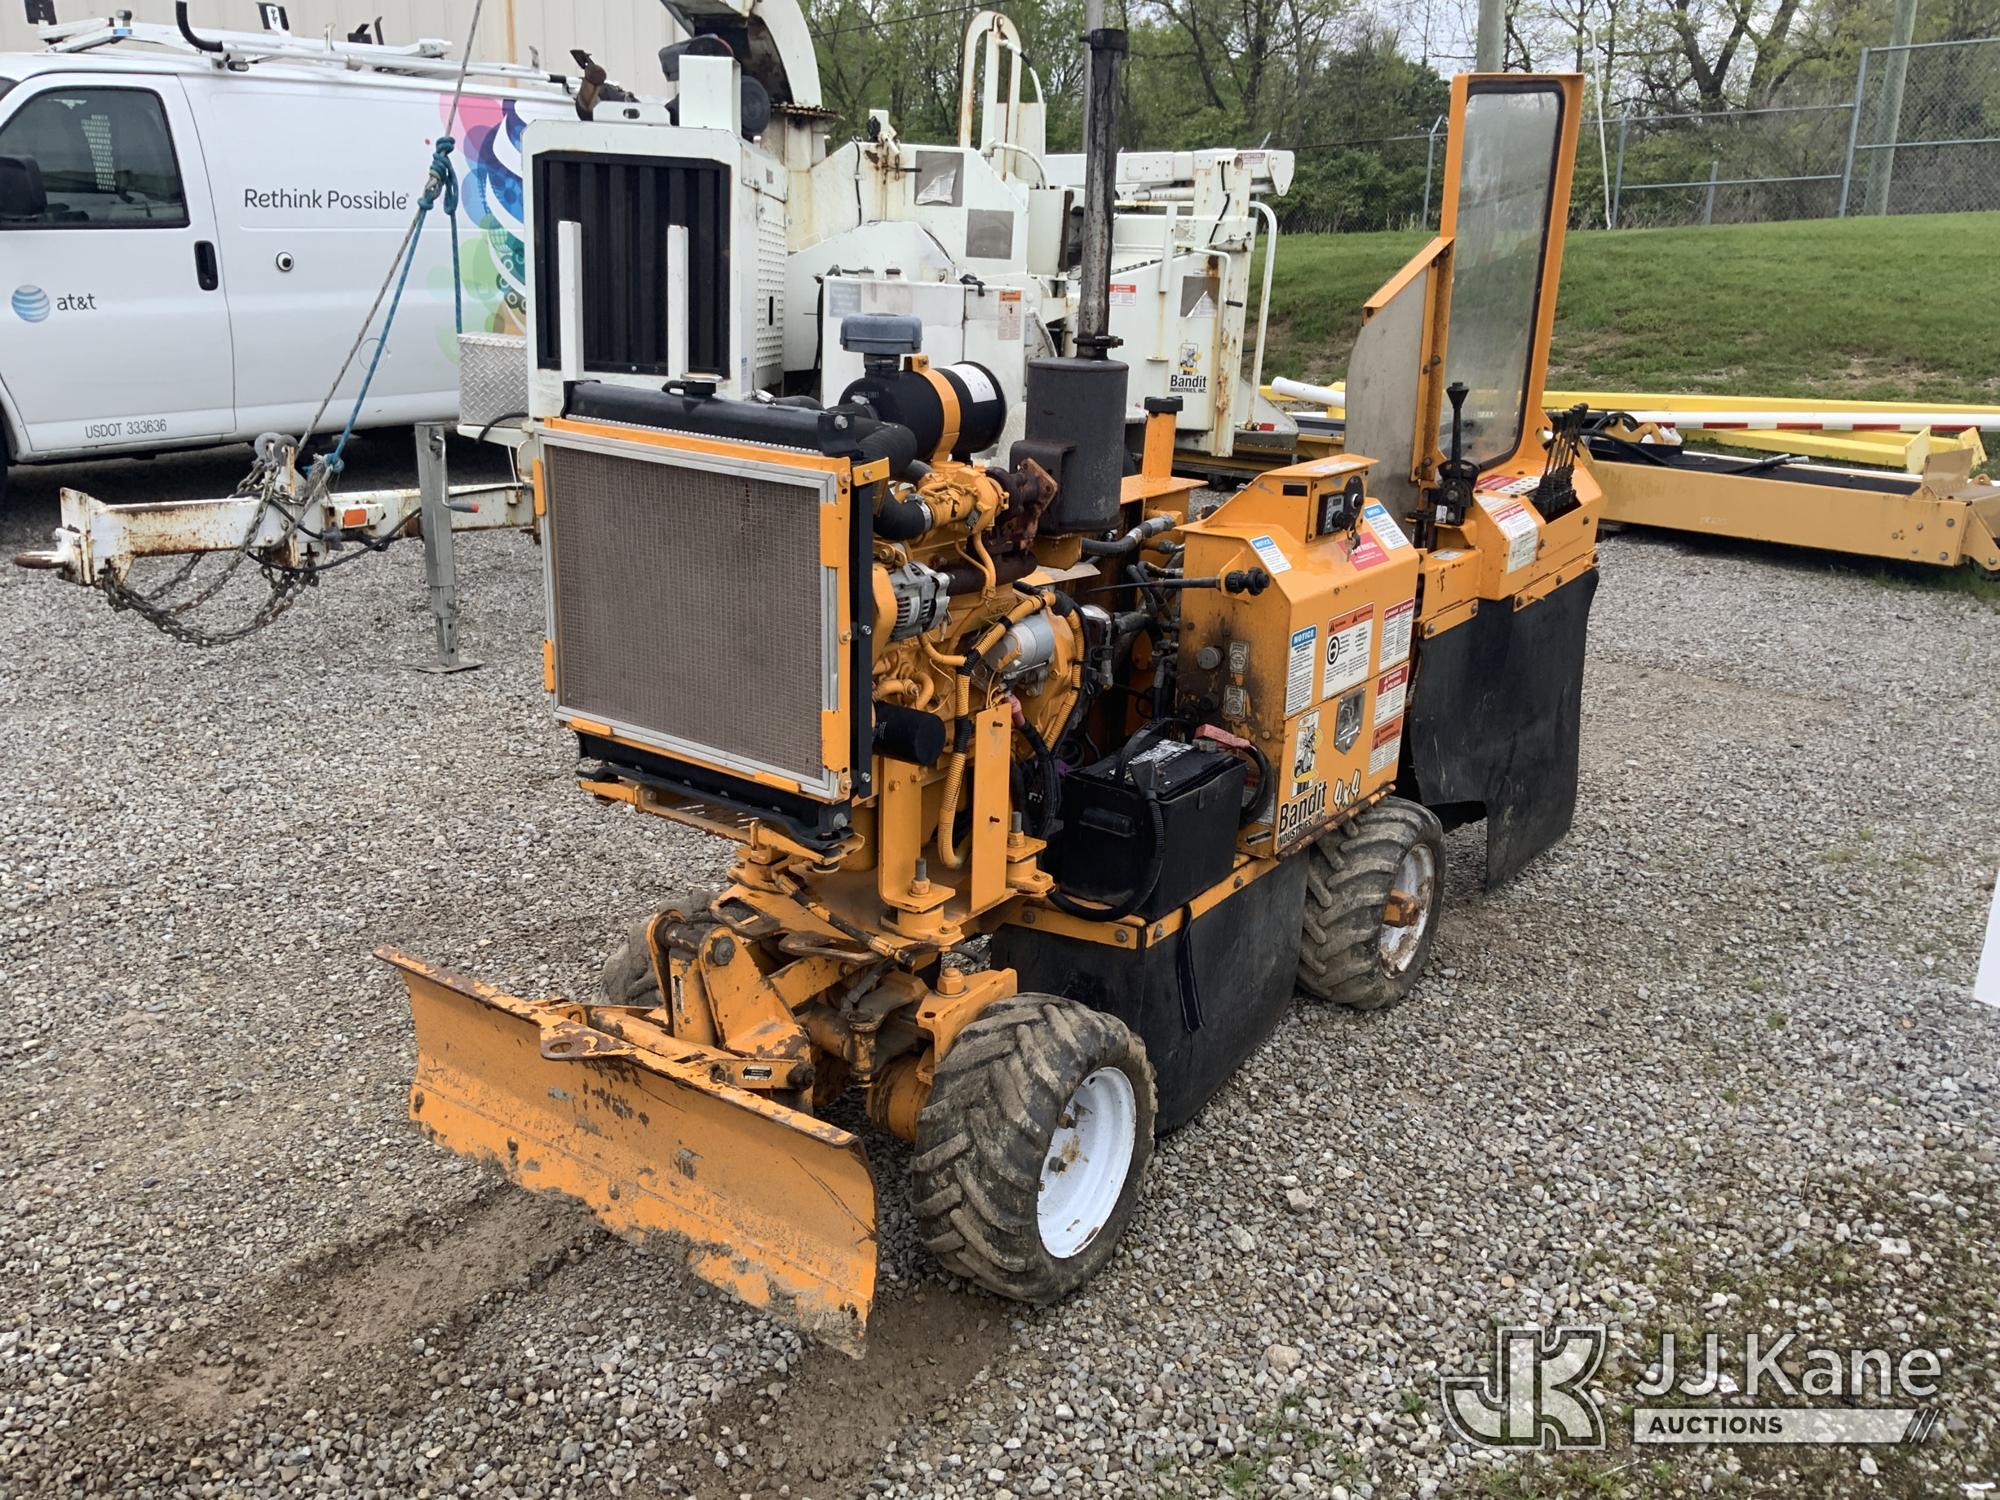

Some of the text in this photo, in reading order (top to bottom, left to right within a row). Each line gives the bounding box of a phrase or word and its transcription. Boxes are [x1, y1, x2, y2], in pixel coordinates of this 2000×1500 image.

[244, 188, 322, 208] Rethink
[56, 293, 97, 311] at&t
[1170, 374, 1207, 387] Bandit
[85, 419, 167, 439] USDOT 333636
[1293, 629, 1315, 644] NOTICE
[1279, 768, 1361, 834] Bandit 4x4
